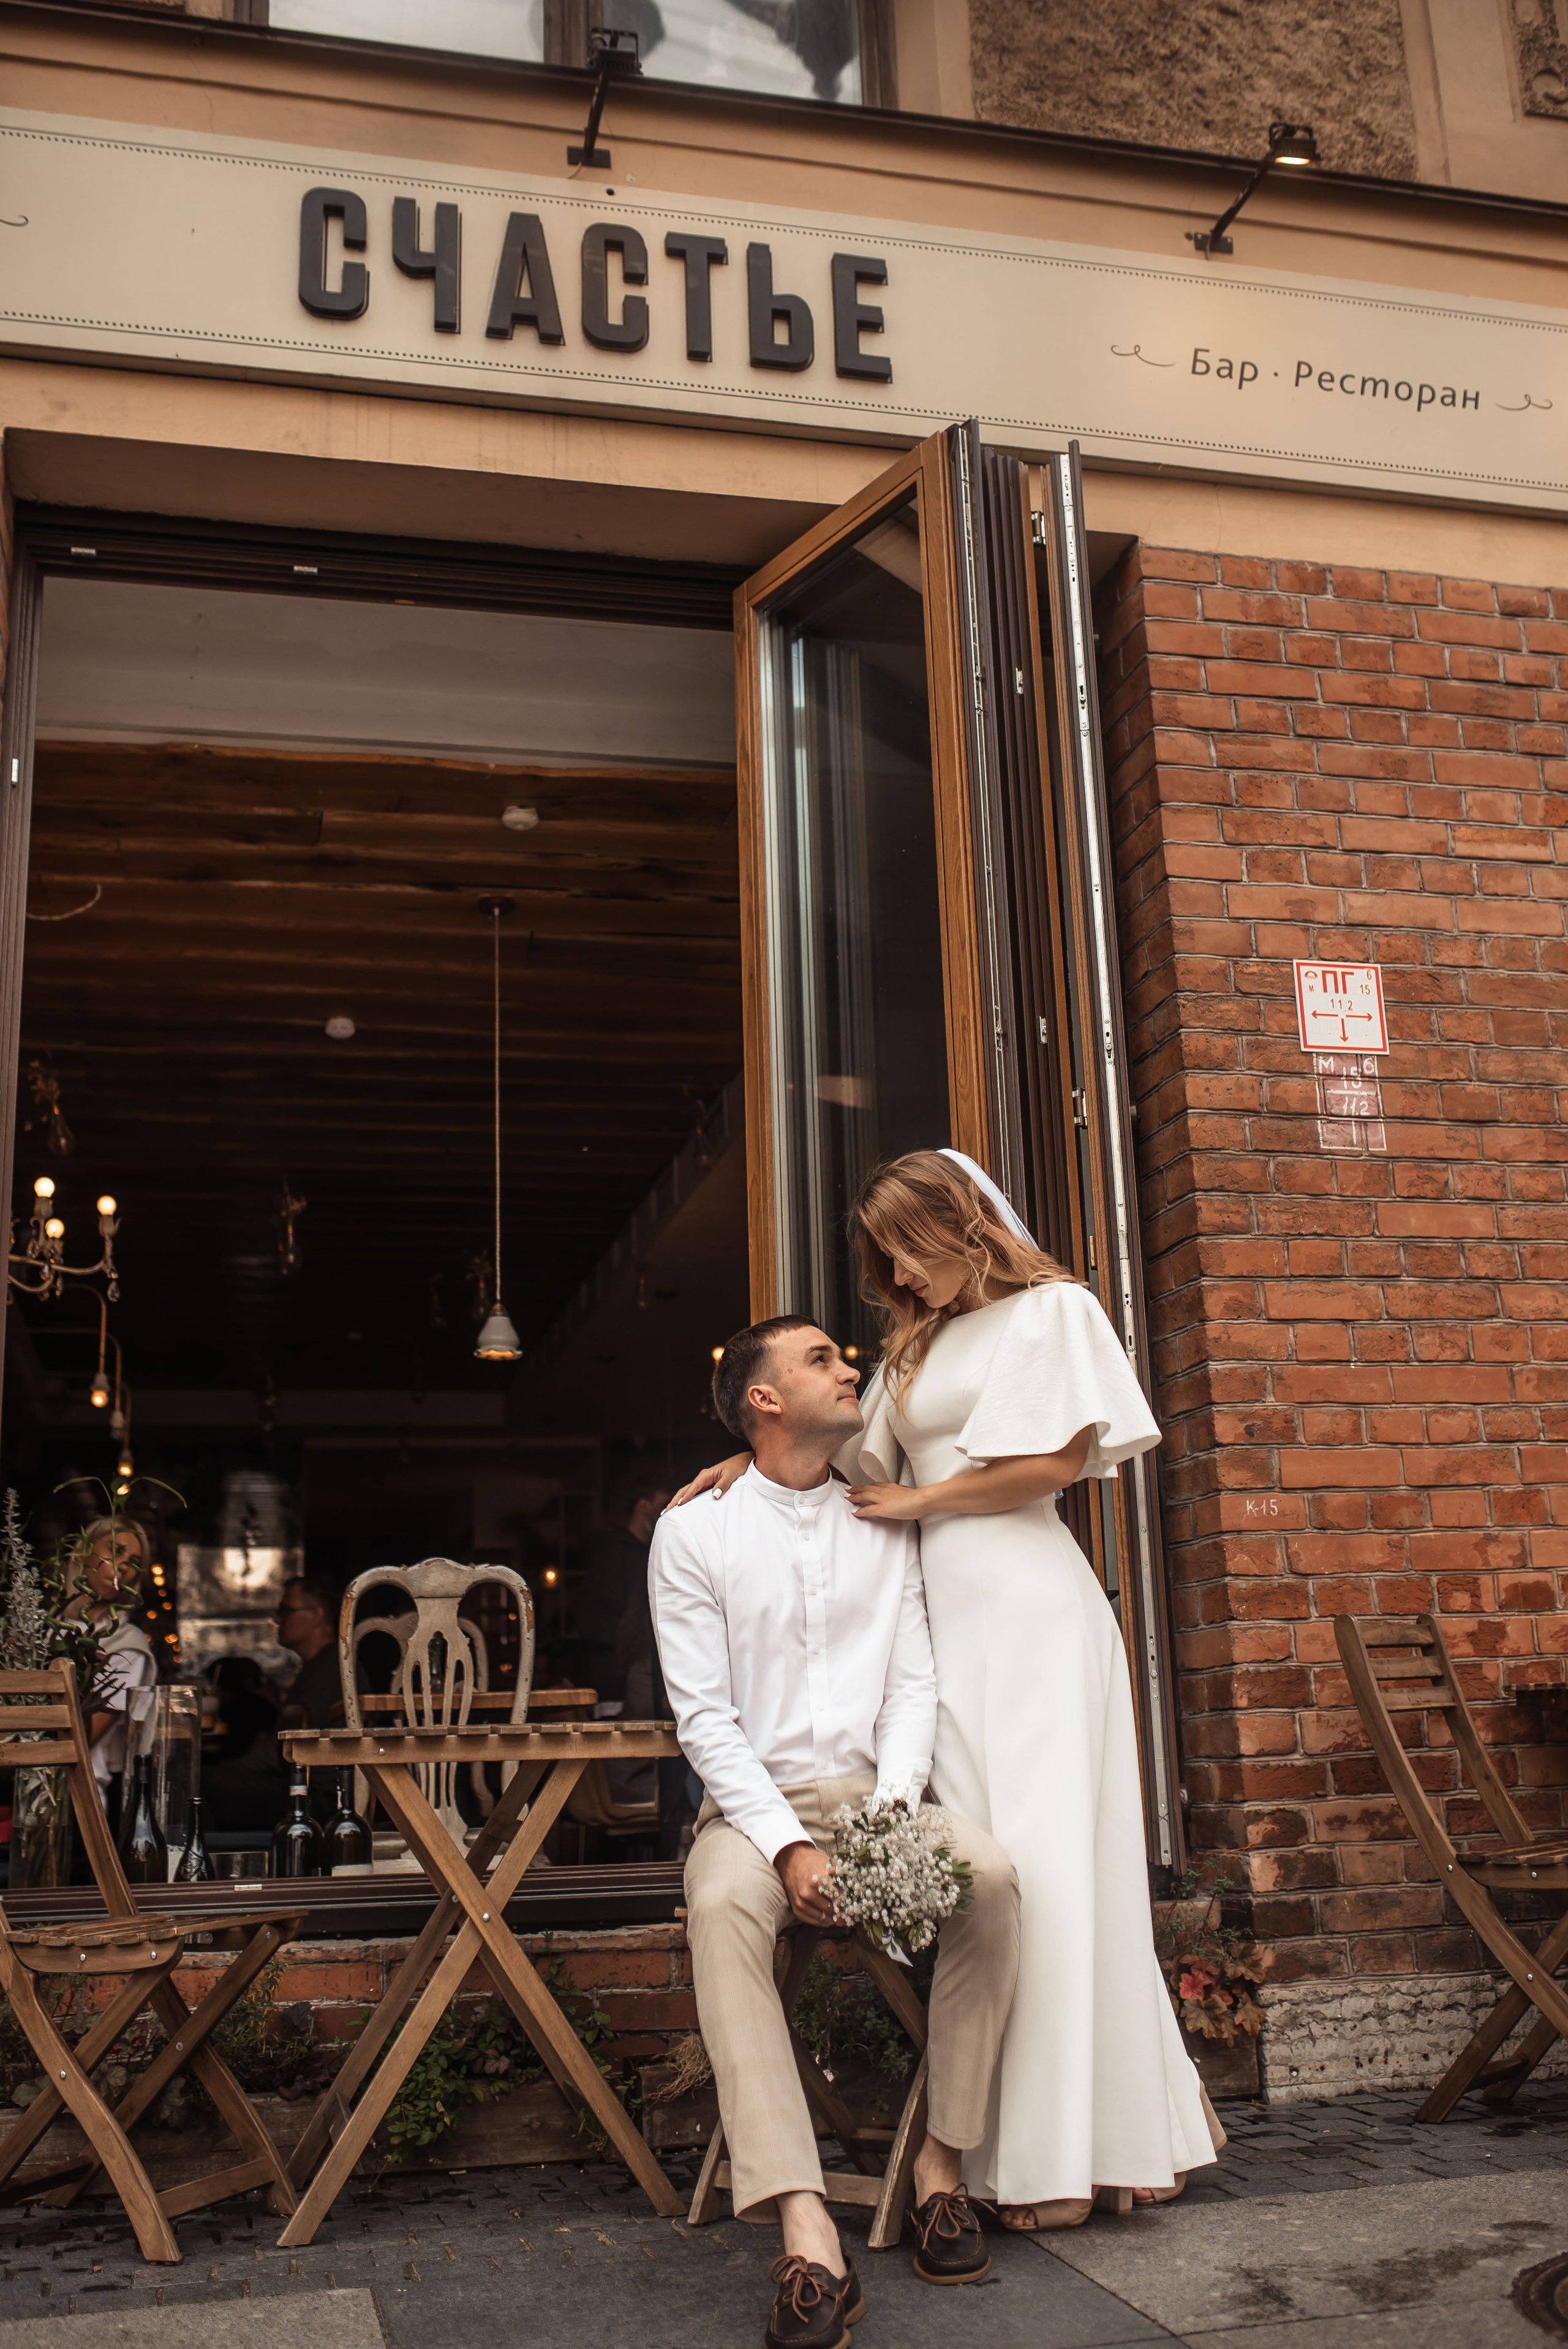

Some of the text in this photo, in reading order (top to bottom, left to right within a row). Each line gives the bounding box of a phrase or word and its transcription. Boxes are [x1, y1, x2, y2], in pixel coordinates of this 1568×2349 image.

[298, 186, 892, 383] СЧАСТЬЕ
[1191, 347, 1480, 412] Бар Ресторан
[1322, 970, 1372, 994] ПГ 6
[1360, 984, 1371, 995] 15
[1341, 1066, 1362, 1089] 15
